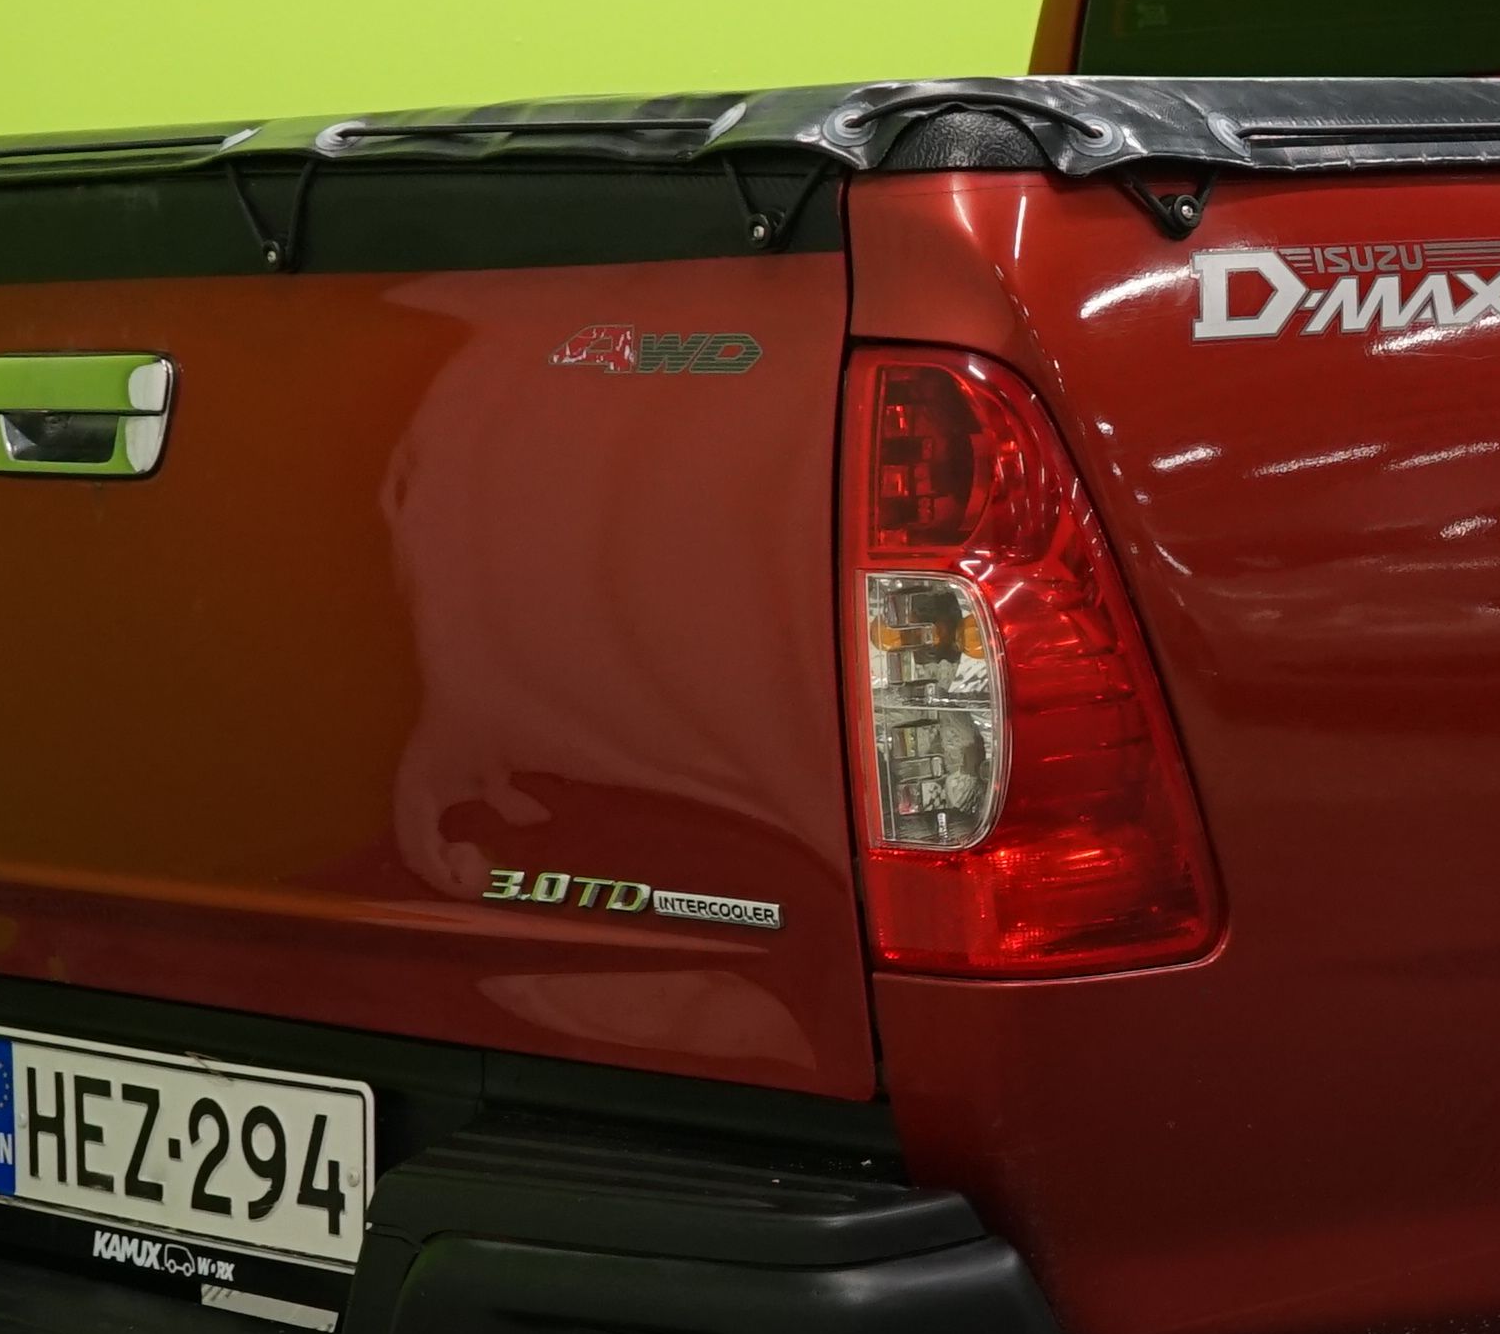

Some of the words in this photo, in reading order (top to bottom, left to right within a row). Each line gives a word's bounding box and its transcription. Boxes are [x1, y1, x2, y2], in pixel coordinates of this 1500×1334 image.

[1310, 245, 1424, 273] ISUZU
[548, 324, 763, 374] 4WD
[482, 869, 651, 913] 3.0TD
[658, 895, 776, 923] INTERCOOLER
[93, 1230, 162, 1270] KAMUX
